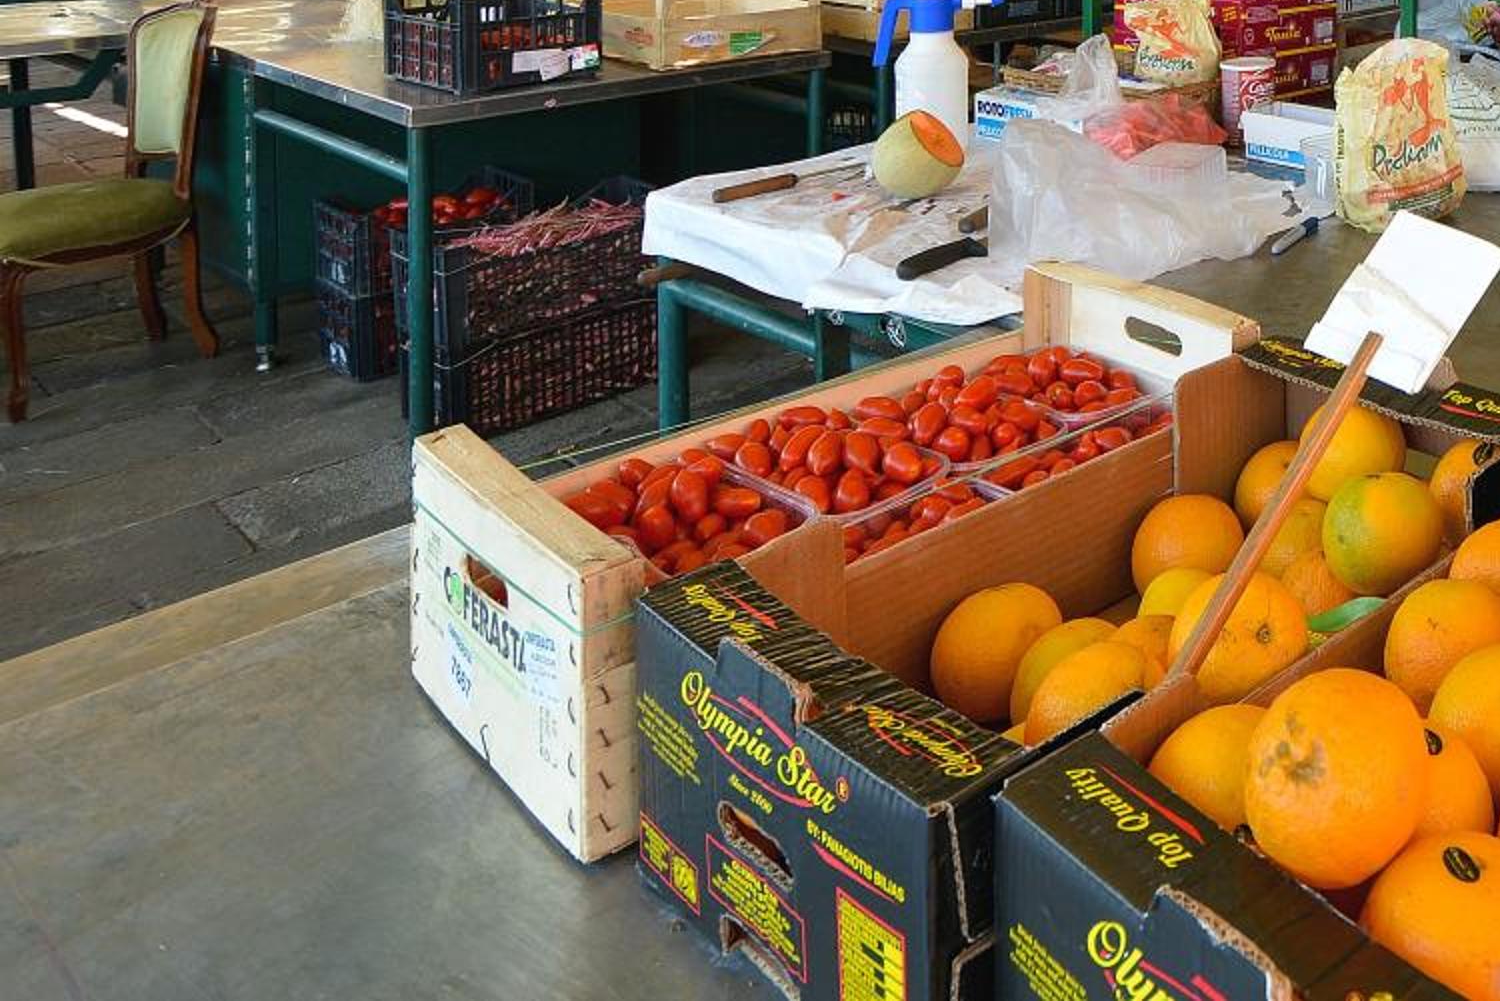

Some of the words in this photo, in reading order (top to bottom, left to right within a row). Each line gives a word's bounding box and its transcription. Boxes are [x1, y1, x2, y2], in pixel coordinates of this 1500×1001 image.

[1442, 389, 1472, 405] Top
[681, 671, 773, 767] Olympia
[777, 746, 837, 815] Star
[1065, 766, 1150, 832] Quality
[1147, 831, 1193, 869] Top
